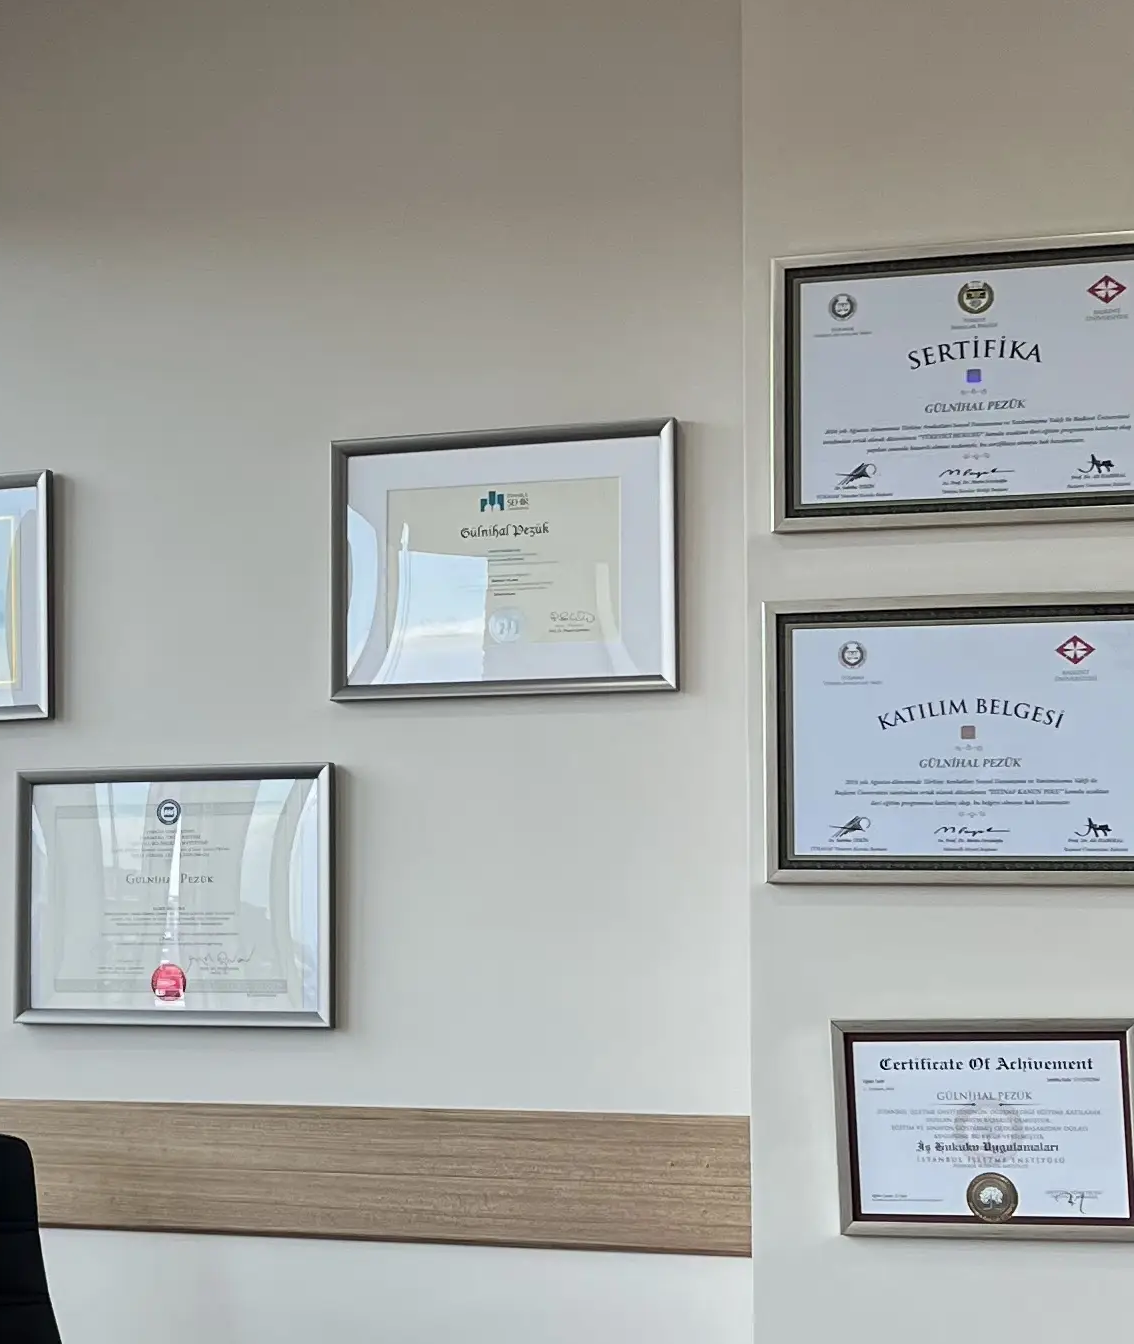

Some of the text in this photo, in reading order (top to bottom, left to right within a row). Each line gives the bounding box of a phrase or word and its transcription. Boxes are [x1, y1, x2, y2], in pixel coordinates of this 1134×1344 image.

[907, 335, 1043, 370] SERTİFİKA
[924, 401, 985, 414] GÜLNİHAL
[877, 697, 1066, 731] KATILIM BELGESİ
[918, 757, 980, 769] GÜLNİHAL
[879, 1057, 1094, 1072] Certificate Of Achivement
